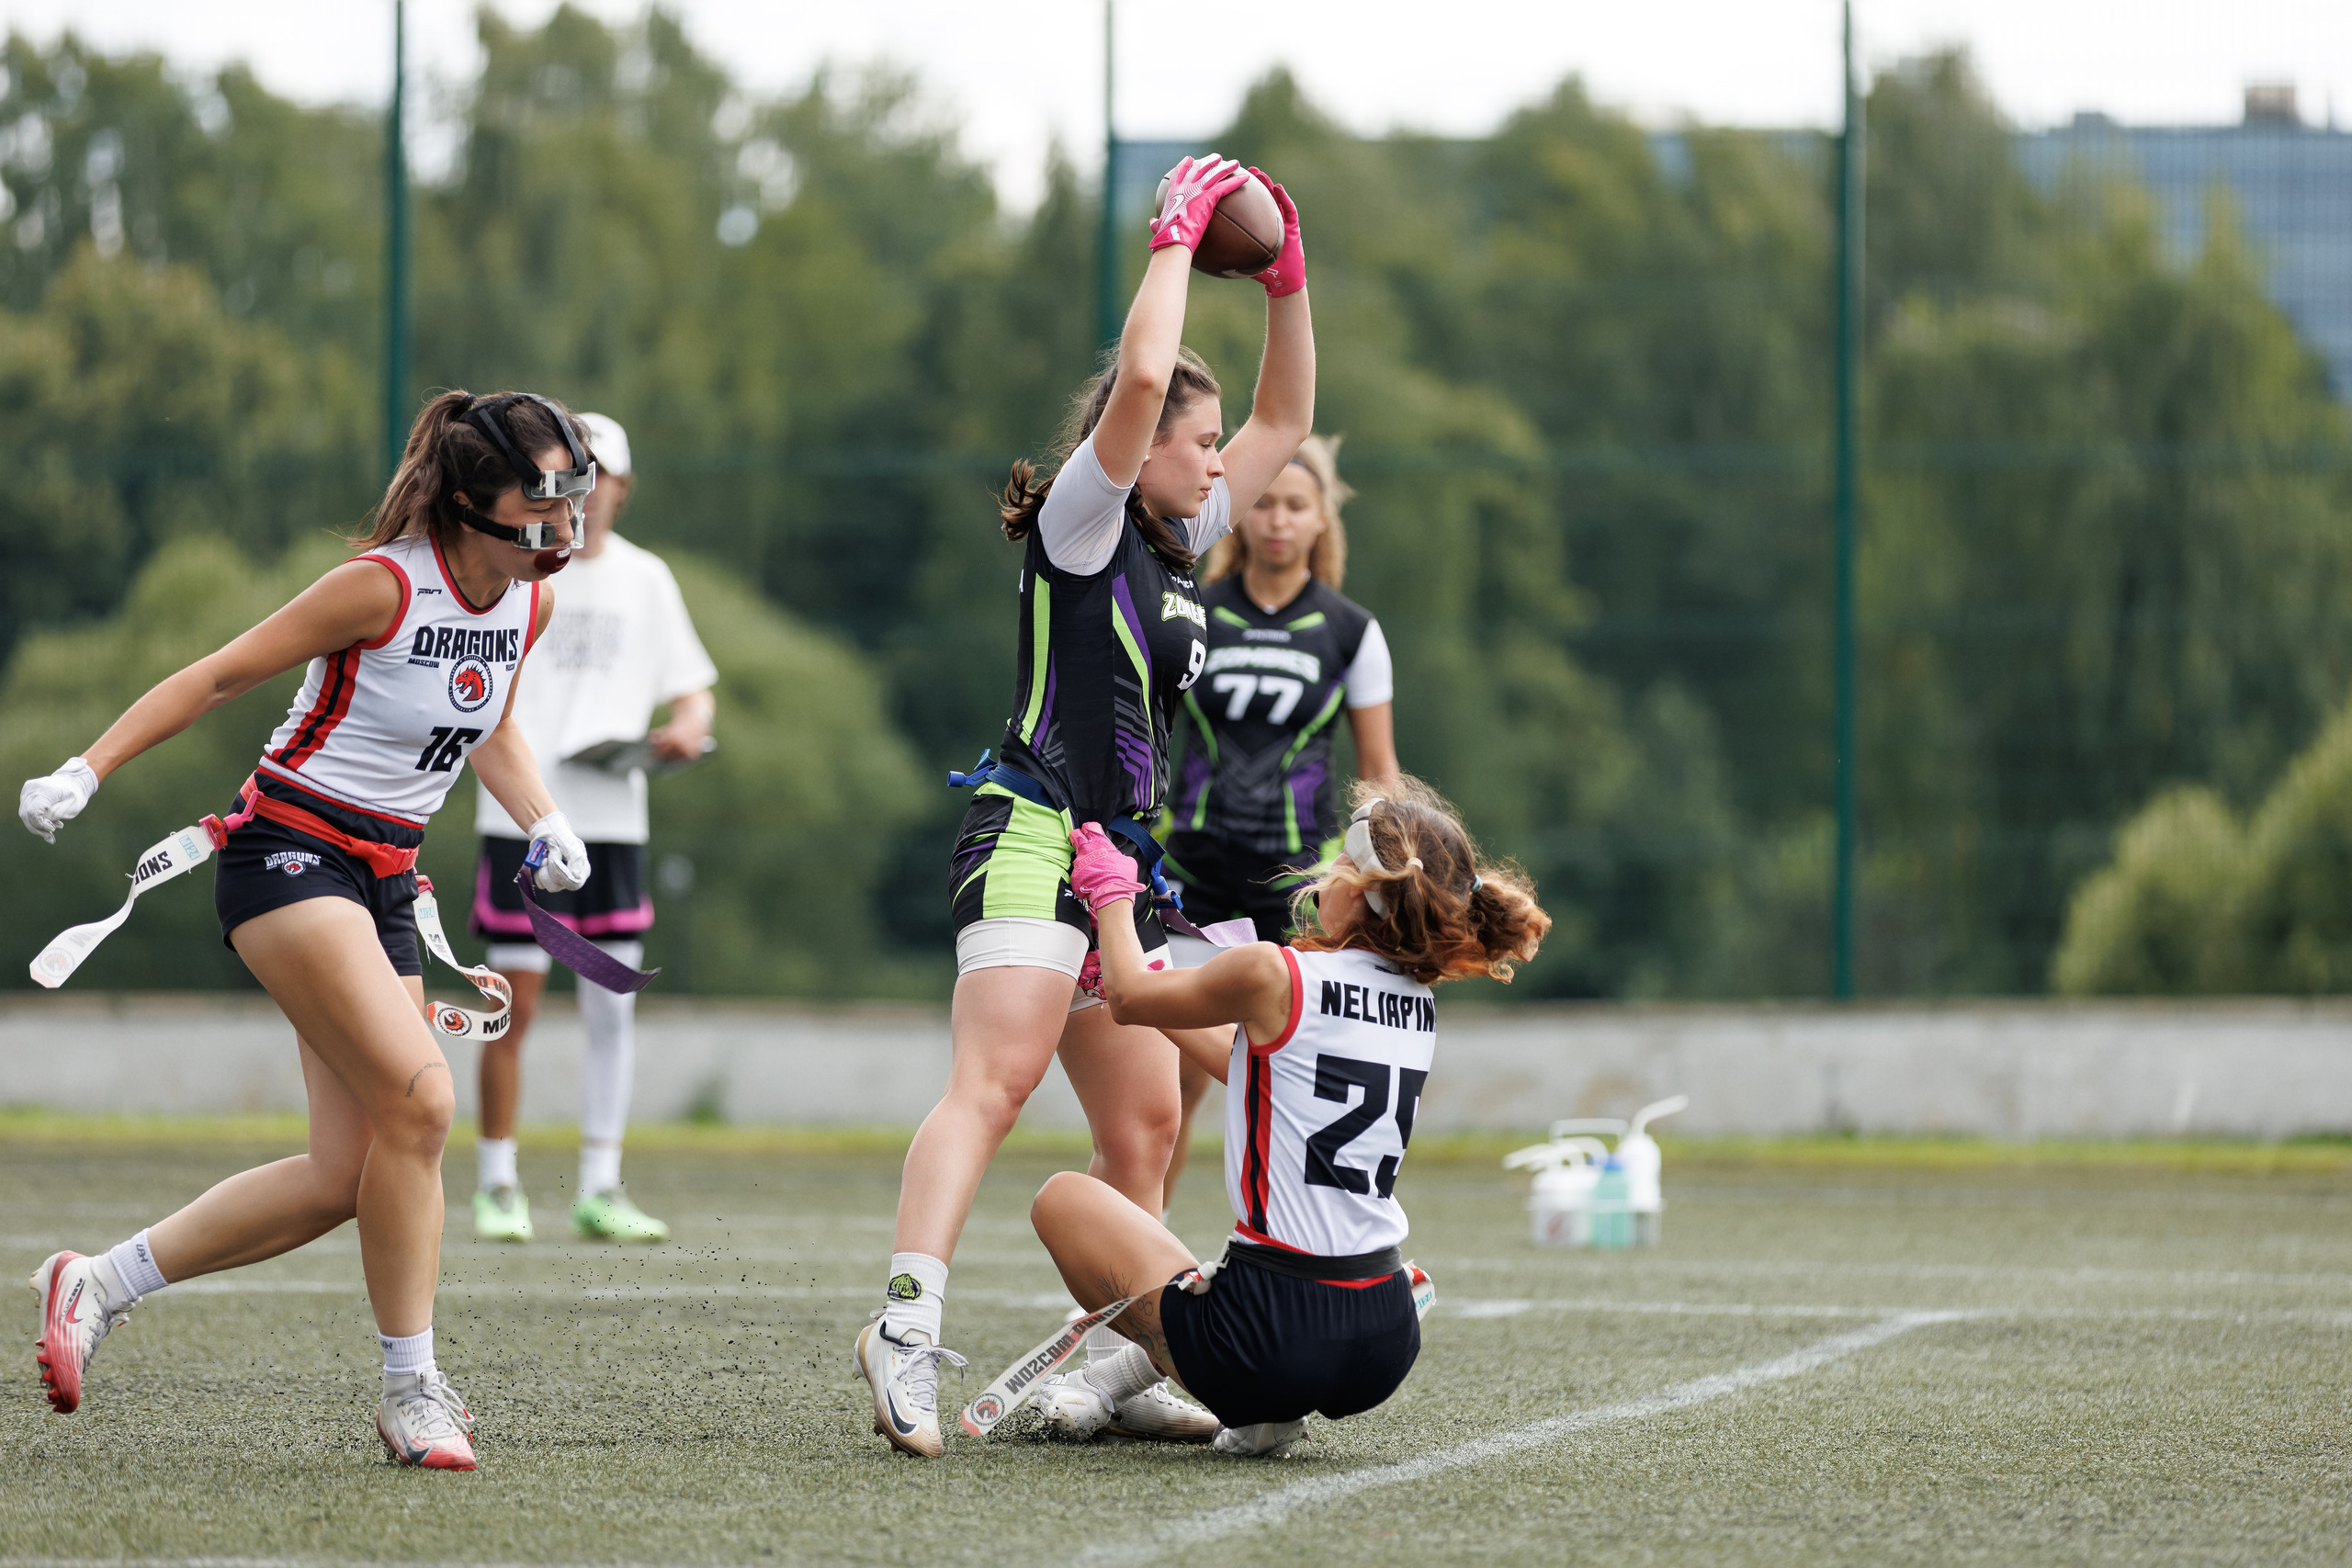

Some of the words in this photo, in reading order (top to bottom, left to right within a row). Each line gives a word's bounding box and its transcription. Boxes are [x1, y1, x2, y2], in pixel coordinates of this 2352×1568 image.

[407, 658, 440, 669] MOSCOW
[411, 626, 519, 662] DRAGONS
[1213, 673, 1304, 725] 77
[414, 726, 484, 773] 16
[1320, 980, 1437, 1032] NELIAPIN
